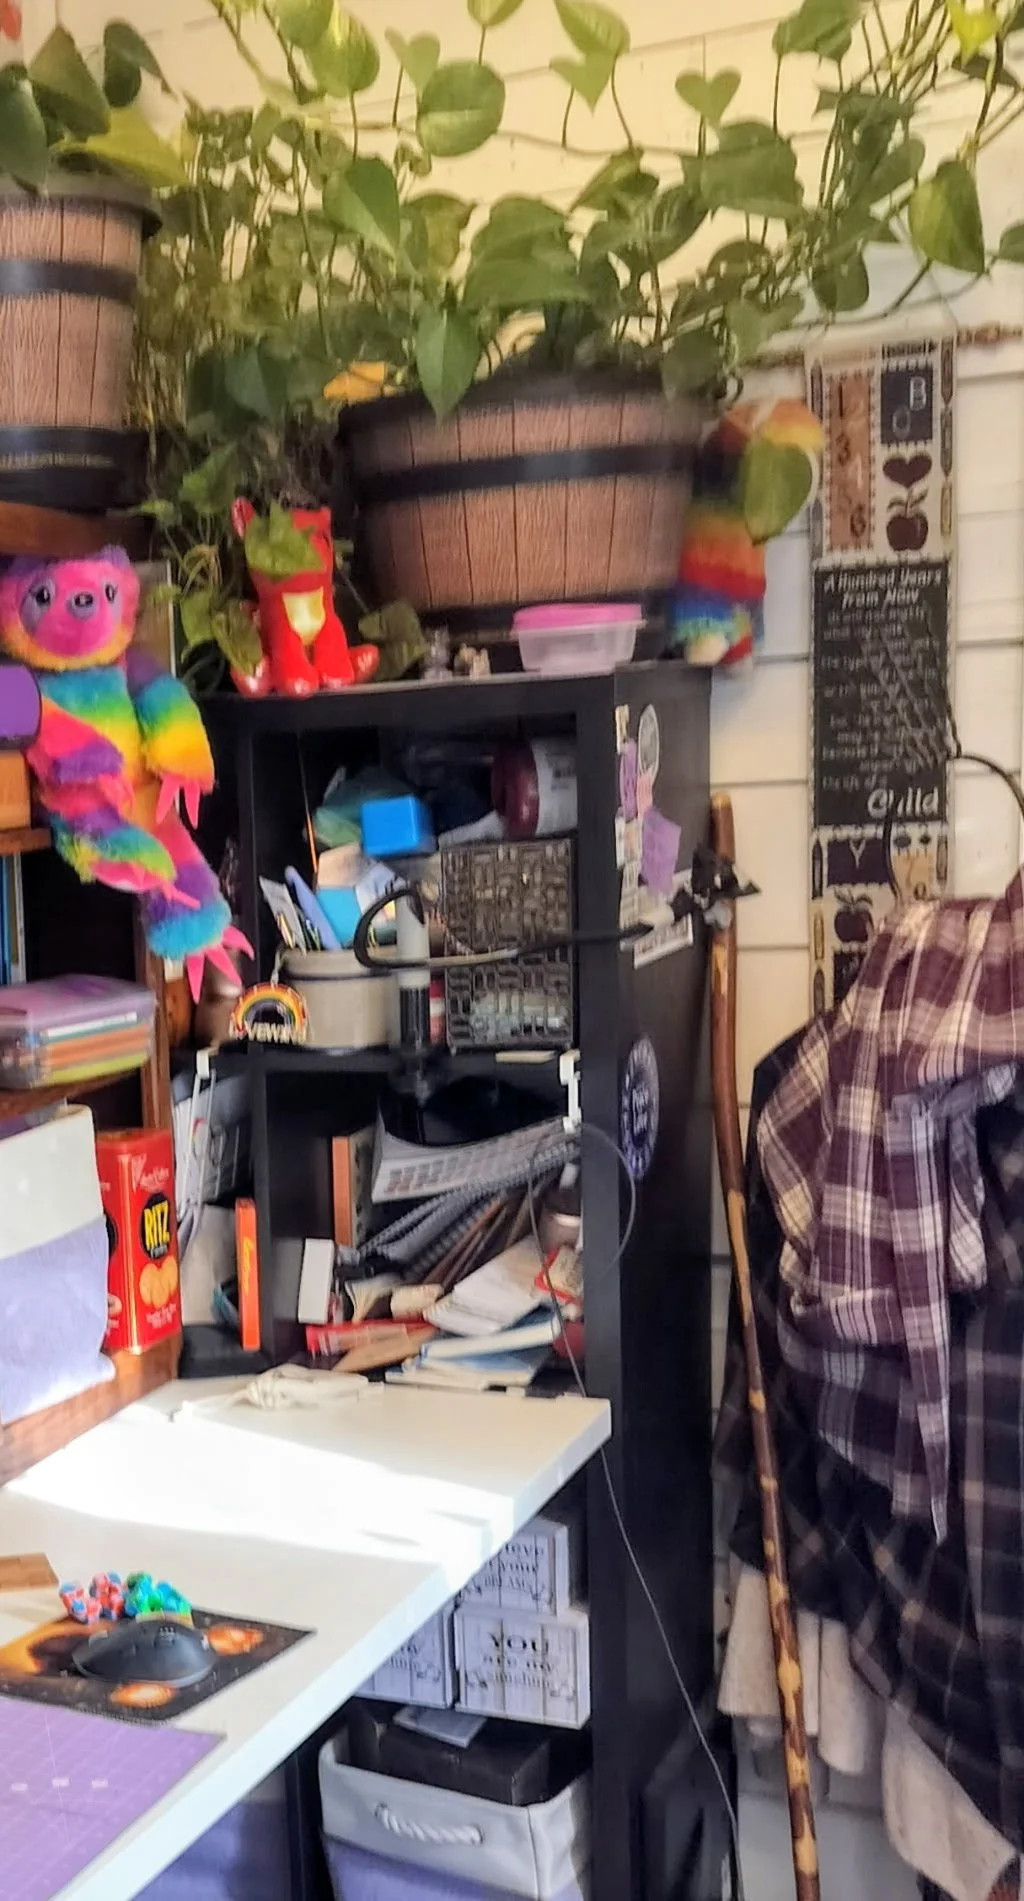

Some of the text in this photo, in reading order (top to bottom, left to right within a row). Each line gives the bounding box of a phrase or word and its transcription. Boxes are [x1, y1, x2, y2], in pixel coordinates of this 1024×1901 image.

[823, 568, 942, 593] A Hundred Years
[142, 1200, 171, 1251] RITZ
[488, 1632, 550, 1655] YOU
